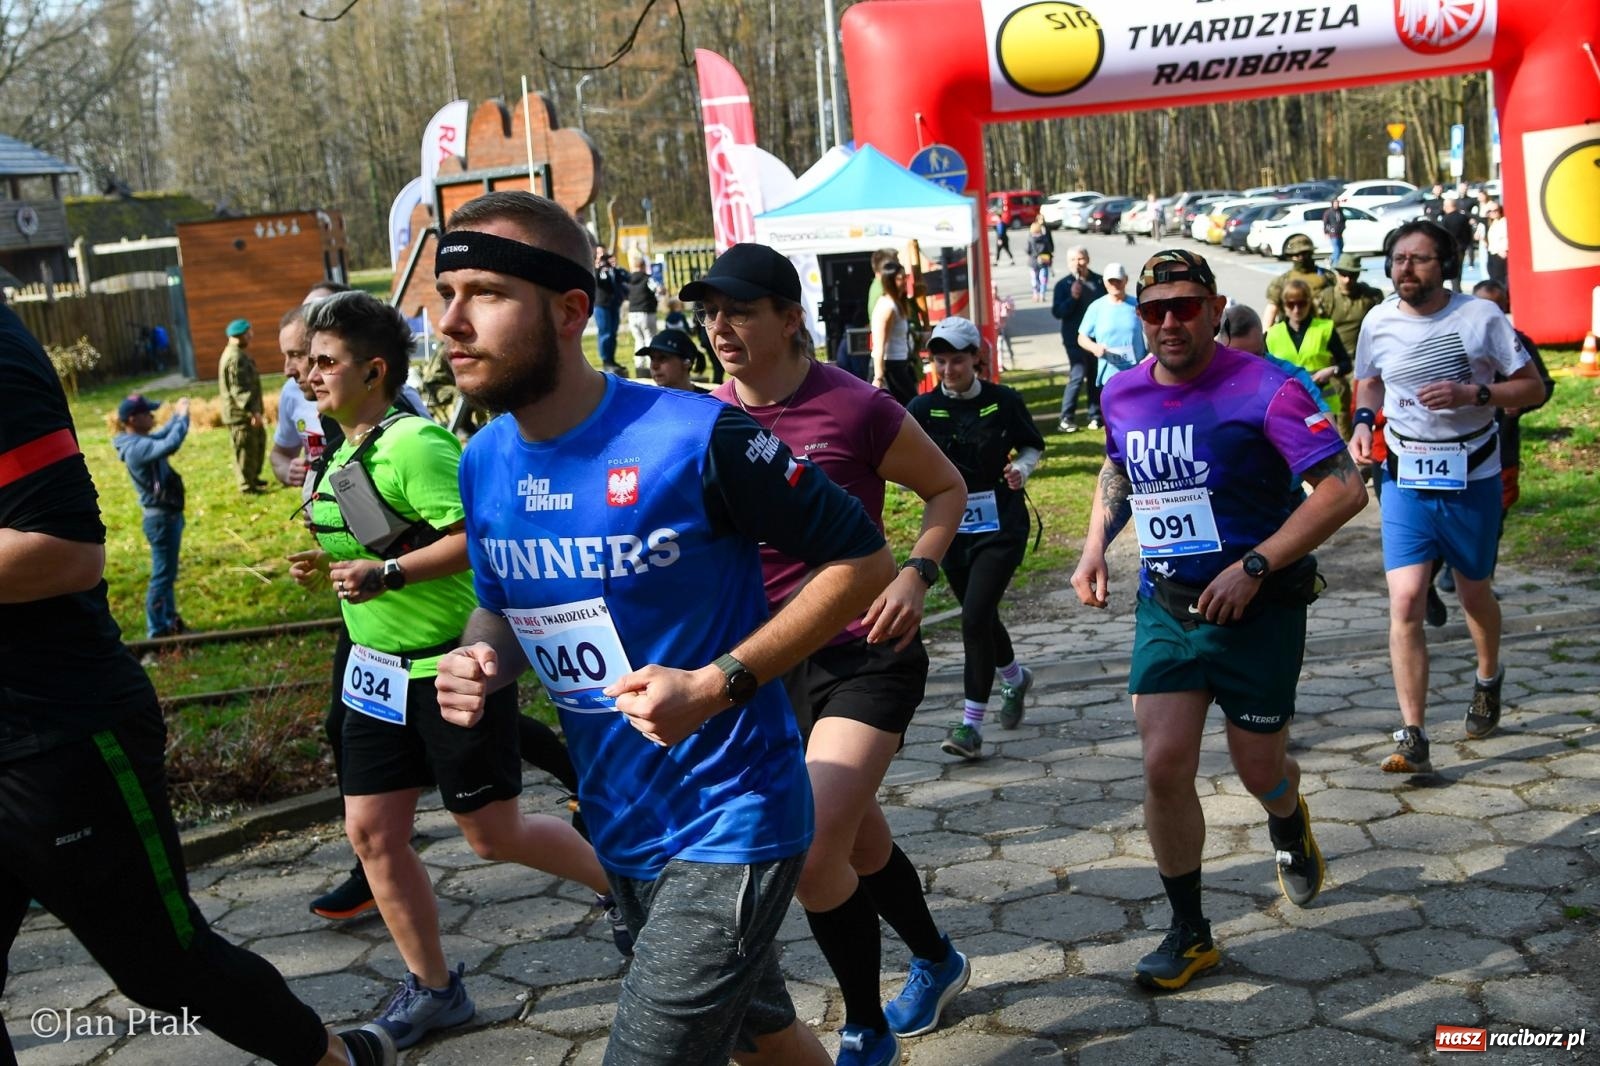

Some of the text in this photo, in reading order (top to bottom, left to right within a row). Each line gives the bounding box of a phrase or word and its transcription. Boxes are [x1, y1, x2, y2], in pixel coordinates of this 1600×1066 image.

[1045, 9, 1099, 30] SIR
[1128, 4, 1359, 50] TWARDZIELA
[1152, 45, 1336, 86] RACIBÓRZ
[607, 456, 641, 465] POLAND
[1127, 424, 1195, 482] RUN
[1415, 458, 1450, 476] 114
[1161, 494, 1202, 504] TWARDZIELA
[1150, 513, 1197, 540] 091
[540, 608, 599, 626] TWARDZIELA
[368, 652, 401, 668] TWARDZIEL
[535, 641, 607, 683] 040
[351, 665, 391, 702] 034
